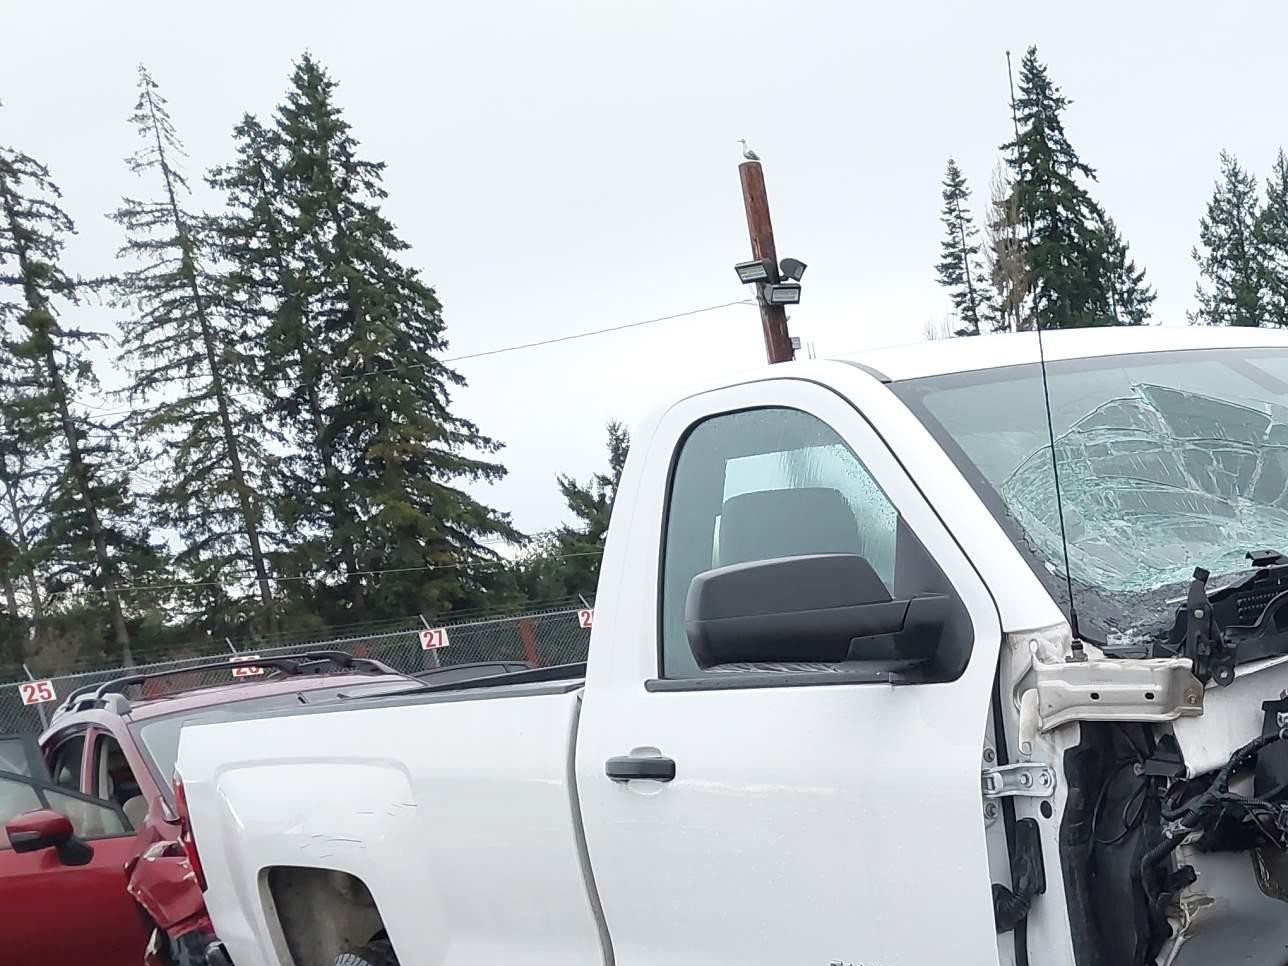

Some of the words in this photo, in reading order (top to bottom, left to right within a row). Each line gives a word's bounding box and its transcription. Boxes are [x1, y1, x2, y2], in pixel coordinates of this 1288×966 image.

[581, 610, 593, 627] 2
[423, 629, 443, 648] 27
[22, 681, 52, 704] 25
